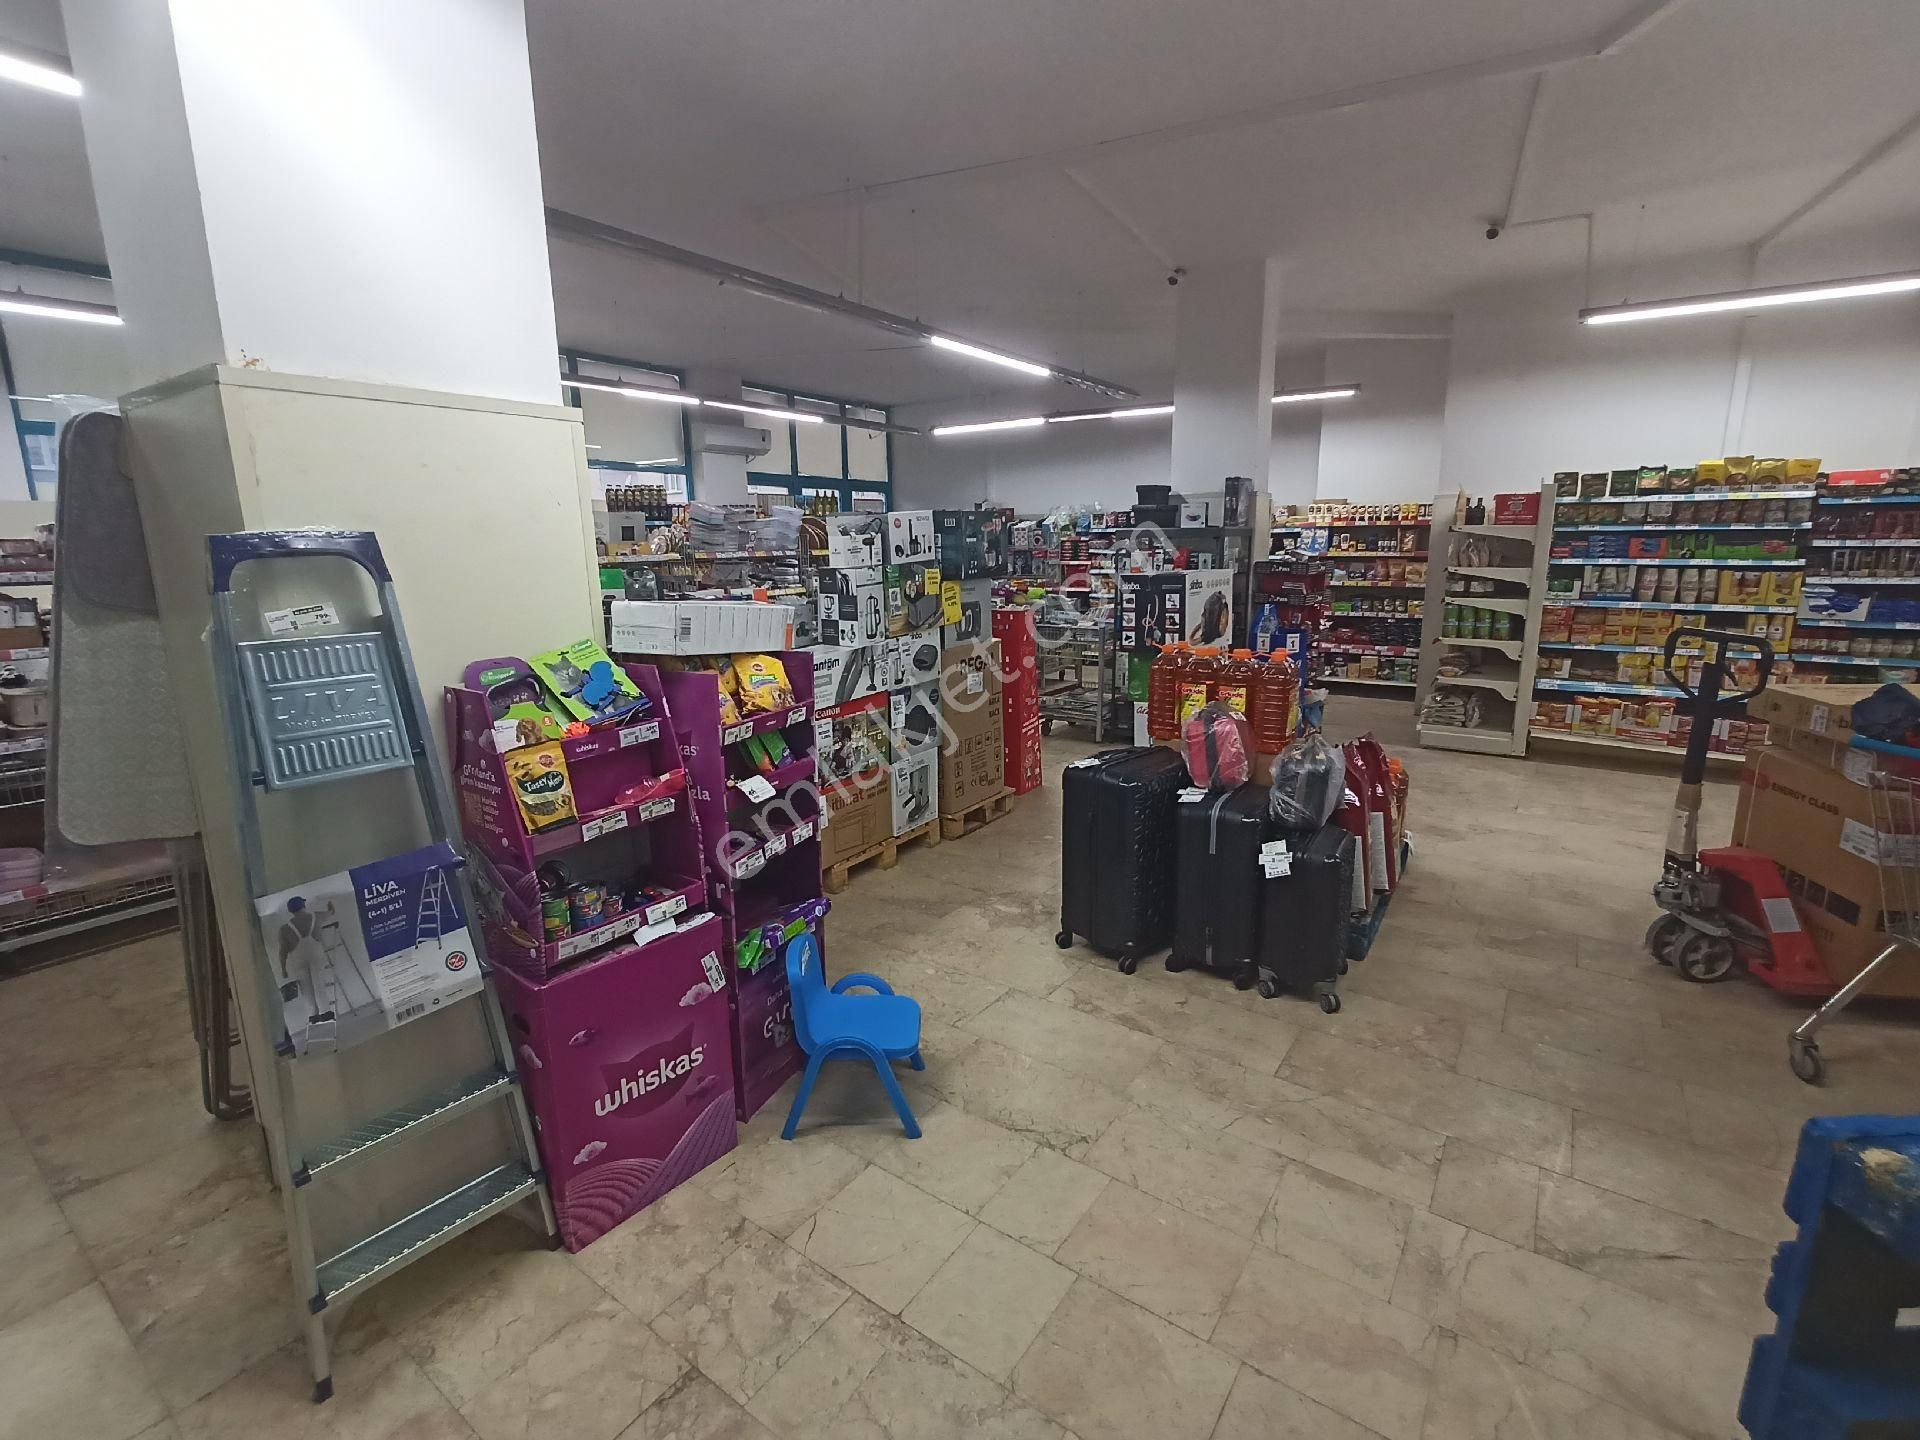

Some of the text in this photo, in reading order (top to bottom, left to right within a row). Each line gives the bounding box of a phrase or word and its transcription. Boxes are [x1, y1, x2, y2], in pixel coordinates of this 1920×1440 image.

[815, 706, 840, 719] Canon
[525, 775, 547, 792] Tasty
[1808, 796, 1839, 815] CLASS
[365, 888, 407, 907] MERDİVEN
[594, 1046, 704, 1117] whiskas
